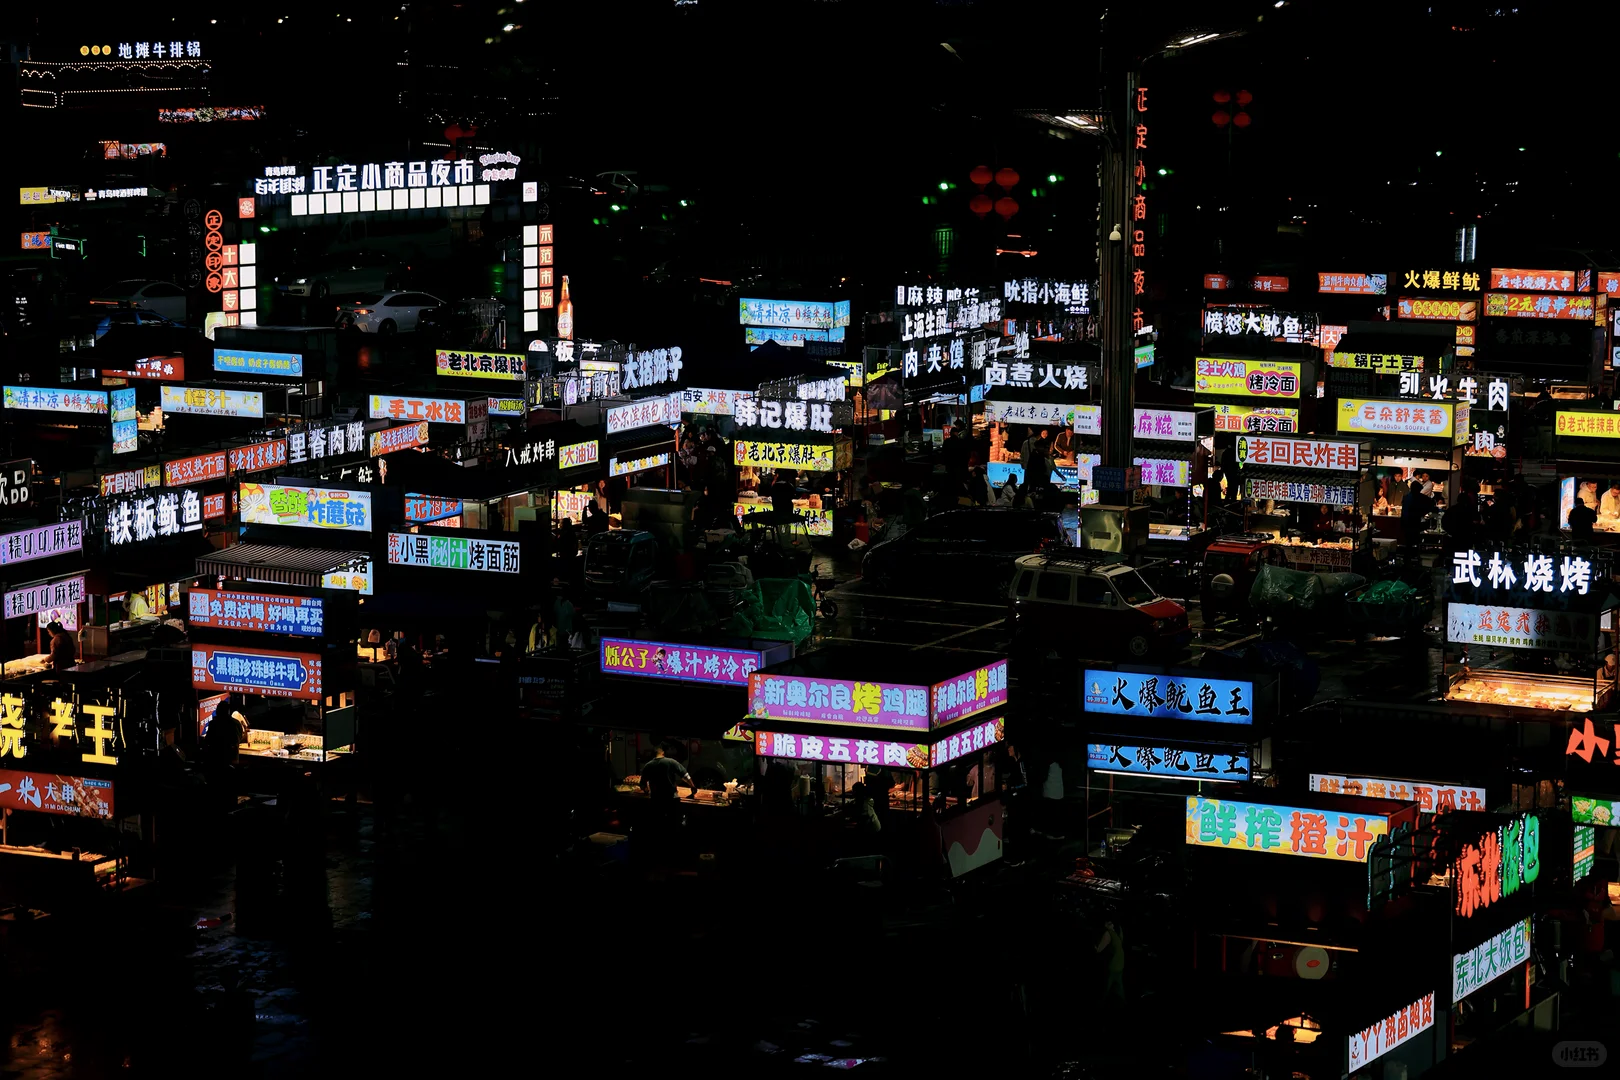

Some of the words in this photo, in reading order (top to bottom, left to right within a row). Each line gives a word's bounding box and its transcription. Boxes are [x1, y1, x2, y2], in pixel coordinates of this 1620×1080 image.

[118, 41, 201, 58] 地摊牛排锅
[312, 159, 475, 193] 正定小商品夜市
[1132, 87, 1149, 330] 正定小商品夜市
[539, 226, 553, 309] 示范市场
[1403, 270, 1481, 291] 火爆鲜鱿
[907, 285, 979, 306] 麻辣鸭货
[1004, 279, 1090, 306] 吮指小海鲜
[1497, 275, 1571, 291] 老味烧烤大串
[752, 302, 791, 323] 清补凉
[1508, 296, 1534, 312] 2元
[902, 308, 947, 342] 上海生煎
[1204, 311, 1301, 339] 愤怒大鱿鱼
[448, 352, 523, 375] 老北京爆肚
[621, 345, 684, 390] 大猪蹄子
[905, 338, 965, 378] 肉夹馍
[1197, 360, 1246, 378] 芝士火鸡
[1354, 354, 1415, 369] 锅巴土豆
[985, 361, 1089, 390] 卤煮火烧
[1249, 374, 1296, 392] 烤冷面
[184, 388, 231, 408] 橙汁
[388, 399, 462, 423] 手工水饺
[684, 389, 704, 402] 西安
[706, 391, 728, 404] 米皮
[608, 401, 671, 430] 哈尔滨锅包肉
[734, 398, 834, 433] 韩记爆肚
[1247, 417, 1294, 433] 烤冷面
[1363, 407, 1443, 426] 云朵舒芙蕾
[1567, 415, 1615, 434] 老式拌辣串
[289, 421, 366, 463] 里脊肉饼
[504, 438, 555, 468] 八戒炸串
[564, 444, 598, 466] 大油边
[748, 443, 816, 464] 老北京爆肚
[1239, 439, 1248, 460] 清真
[1249, 439, 1358, 469] 老回民炸串
[171, 457, 225, 479] 武汉热干面
[109, 489, 204, 546] 铁板鱿鱼
[269, 489, 308, 515] 香酥
[307, 499, 365, 525] 炸蘑菇
[389, 534, 400, 563] 东北
[401, 535, 519, 573] 小黑秘汁烤面筋
[1310, 551, 1351, 566] 炸淀粉肠
[1452, 549, 1592, 596] 武林烧烤
[209, 599, 264, 621] 免费试喝
[267, 604, 324, 626] 好喝再买
[216, 656, 300, 682] 黑糖珍珠鲜牛乳
[666, 650, 756, 680] 爆汁烤冷面
[764, 678, 928, 717] 新奥尔良烤鸡腿
[937, 663, 1007, 713] 新奥尔良烤鸡腿
[1110, 677, 1250, 716] 火爆鱿鱼王
[773, 733, 908, 766] 脆皮五花肉
[936, 722, 996, 765] 脆皮五花肉
[1565, 717, 1620, 766] 小
[1108, 744, 1249, 775] 火爆鱿鱼王
[1200, 801, 1375, 860] 鲜榨橙汁
[1456, 812, 1540, 918] 东北饭包
[1455, 922, 1527, 997] 东北大饭包
[1361, 990, 1433, 1061] 丫丫热卤鸭货
